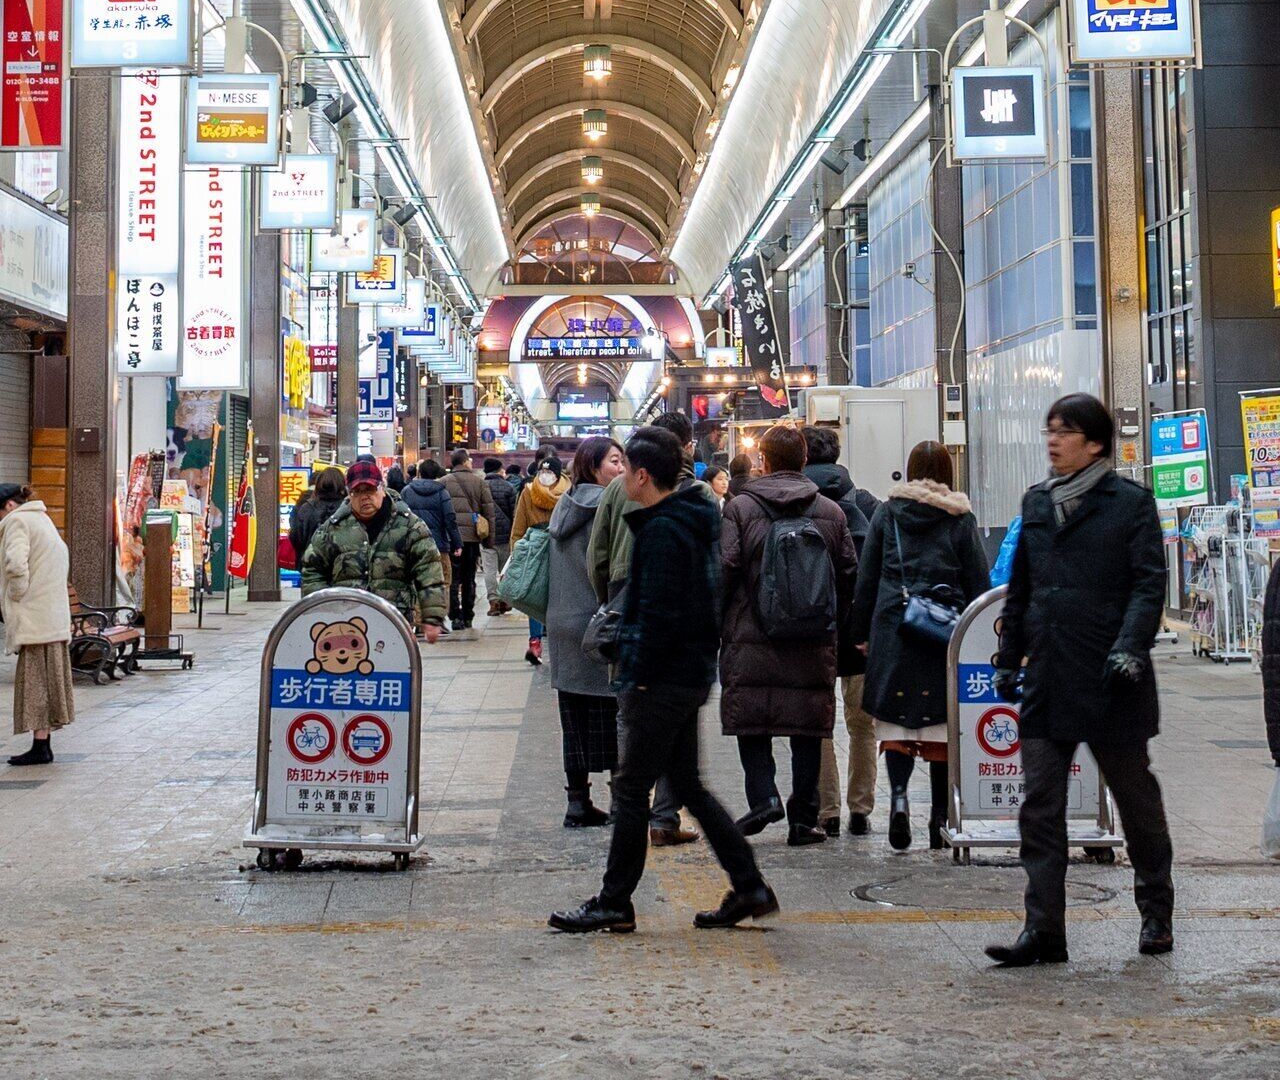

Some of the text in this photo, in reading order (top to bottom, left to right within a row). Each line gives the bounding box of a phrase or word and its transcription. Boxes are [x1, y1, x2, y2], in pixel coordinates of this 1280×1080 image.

[107, 4, 158, 12] akatsuka
[7, 30, 60, 43] 空室情報
[121, 40, 138, 59] 3
[1125, 36, 1142, 53] 3
[198, 113, 211, 122] 2F
[138, 93, 157, 242] 2nd STREET
[292, 189, 324, 197] STREET
[208, 198, 223, 278] STREET
[152, 301, 163, 351] 相撲茶屋
[186, 325, 235, 340] 古着買取
[559, 348, 597, 356] Therefore
[599, 349, 625, 357] people
[279, 676, 403, 707] 歩行者専用
[286, 767, 389, 784] 防犯カメラ作動中
[298, 788, 376, 801] 狸小路商店街
[298, 801, 376, 814] 中央警察署
